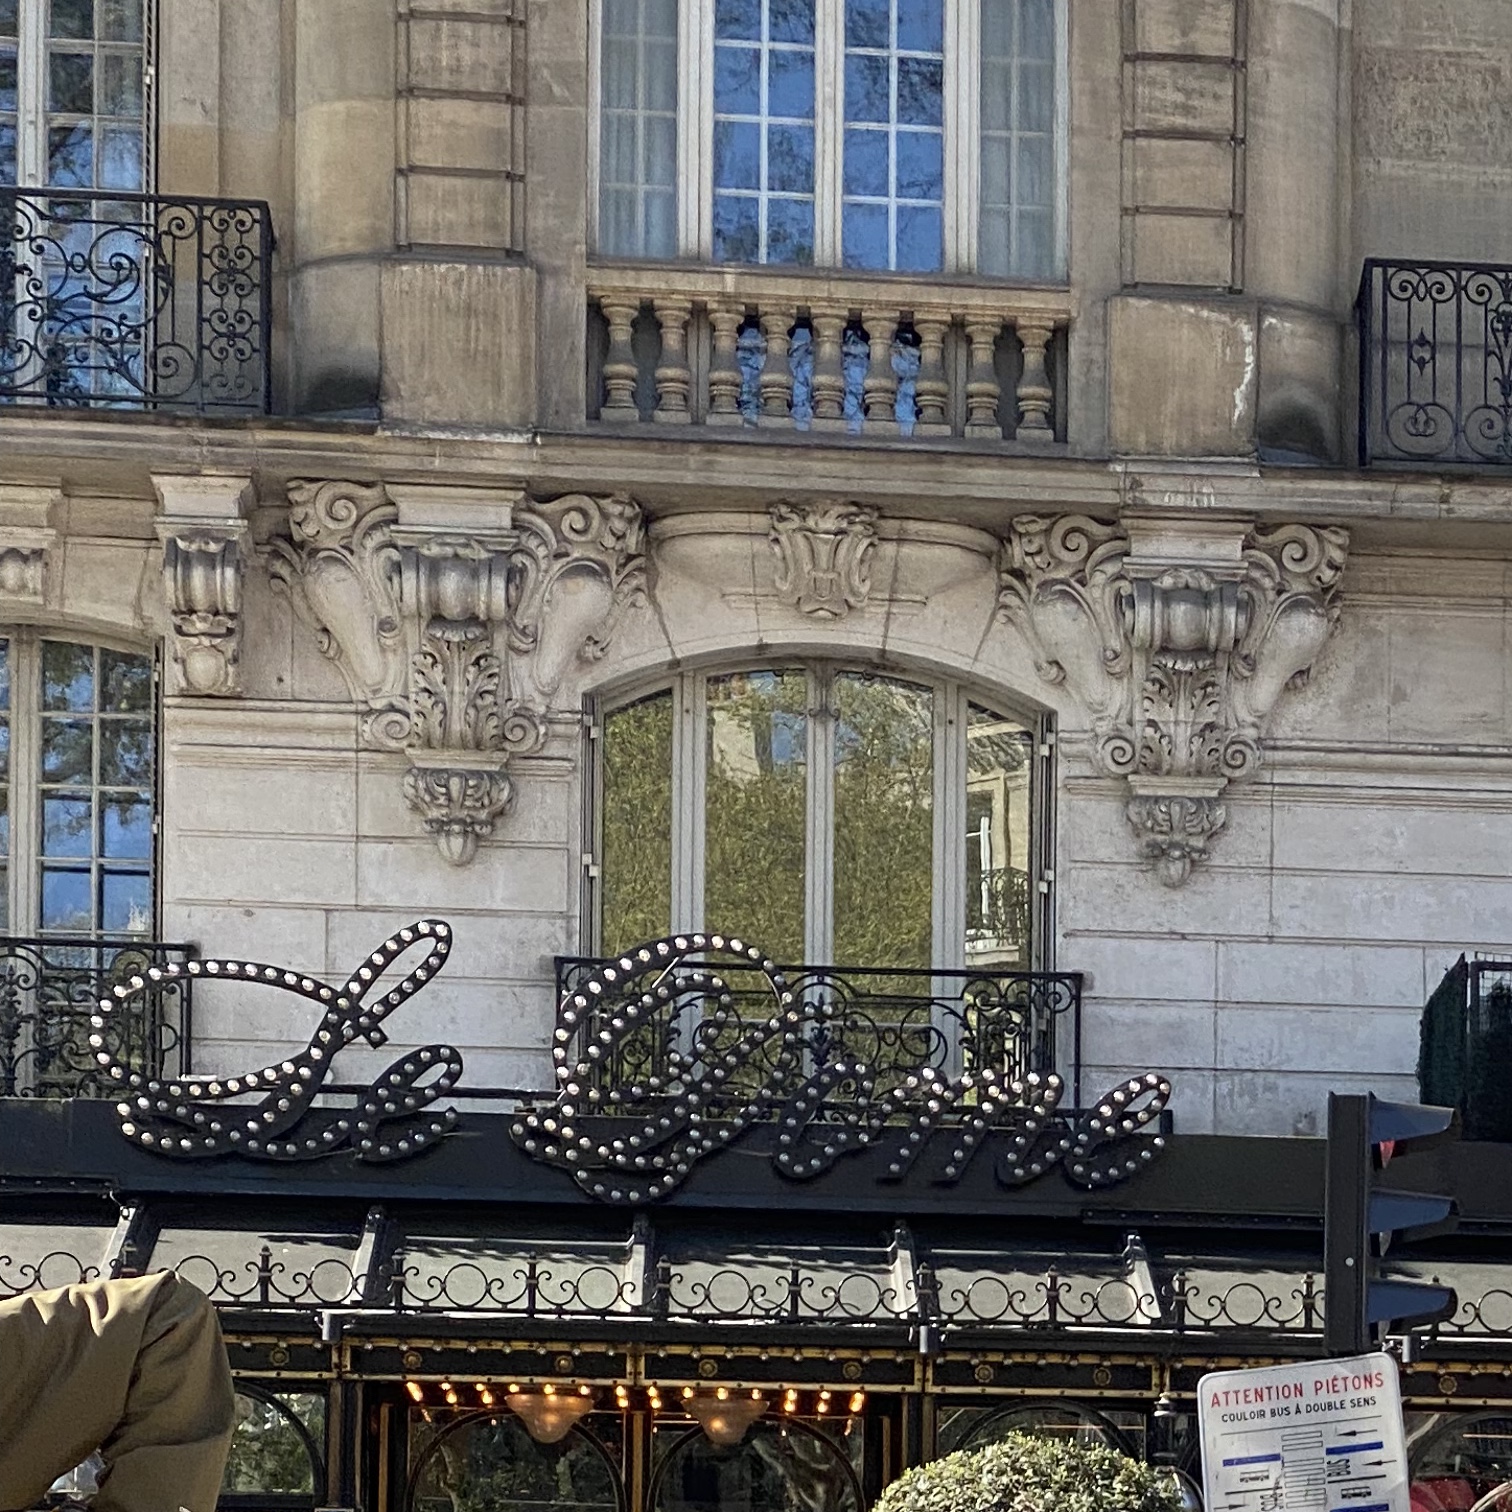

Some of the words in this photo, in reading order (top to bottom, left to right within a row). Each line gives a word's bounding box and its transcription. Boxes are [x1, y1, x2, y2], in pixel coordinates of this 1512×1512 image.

[92, 919, 462, 1162] Le
[1212, 1383, 1303, 1408] ATTENTION
[1314, 1373, 1383, 1396] PIÉTONS
[1222, 1409, 1265, 1422] COULOIR
[1271, 1406, 1290, 1417] BUS
[1306, 1400, 1345, 1413] DOUBLE
[1350, 1396, 1376, 1408] SENS
